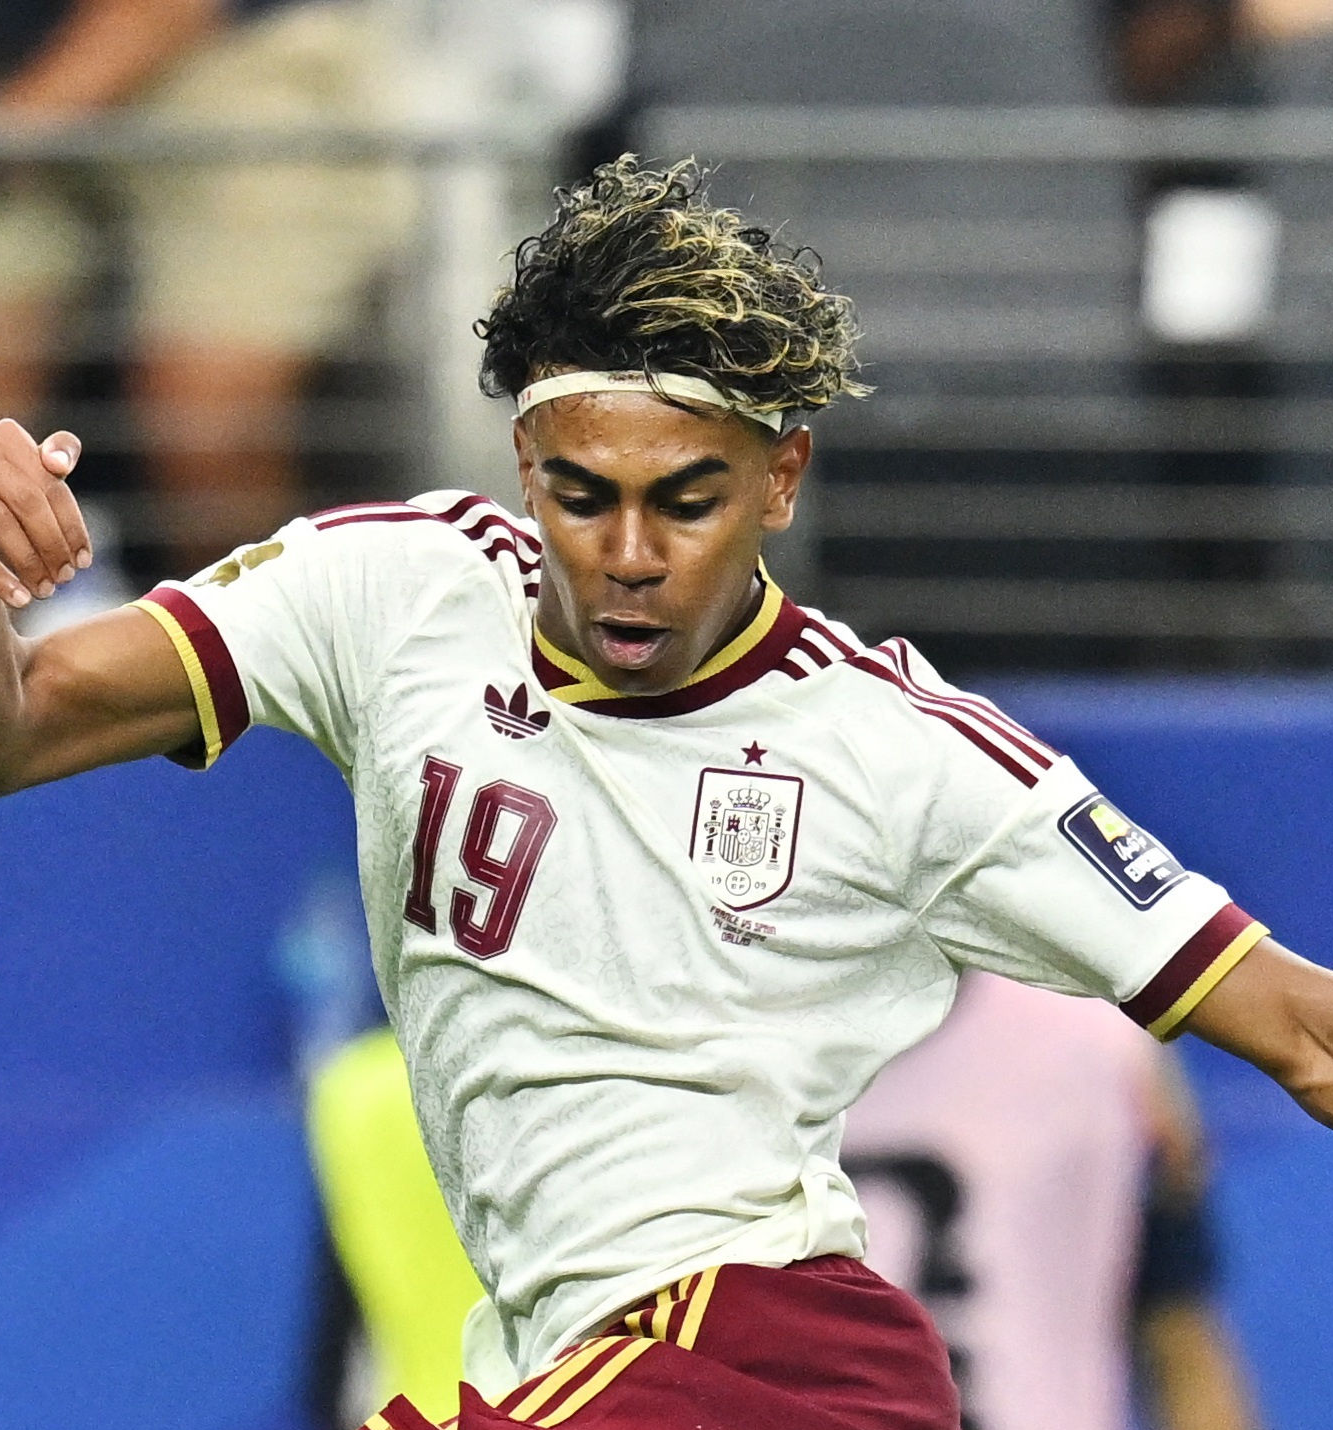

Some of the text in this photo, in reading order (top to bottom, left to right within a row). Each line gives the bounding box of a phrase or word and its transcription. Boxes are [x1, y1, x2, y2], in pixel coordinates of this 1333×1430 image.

[403, 754, 558, 961] 19
[711, 875, 722, 885] 19
[754, 881, 767, 890] 09
[710, 905, 740, 926] FRANCE
[754, 922, 777, 935] SPAIN
[713, 918, 723, 930] 14
[721, 931, 752, 946] DALLAS
